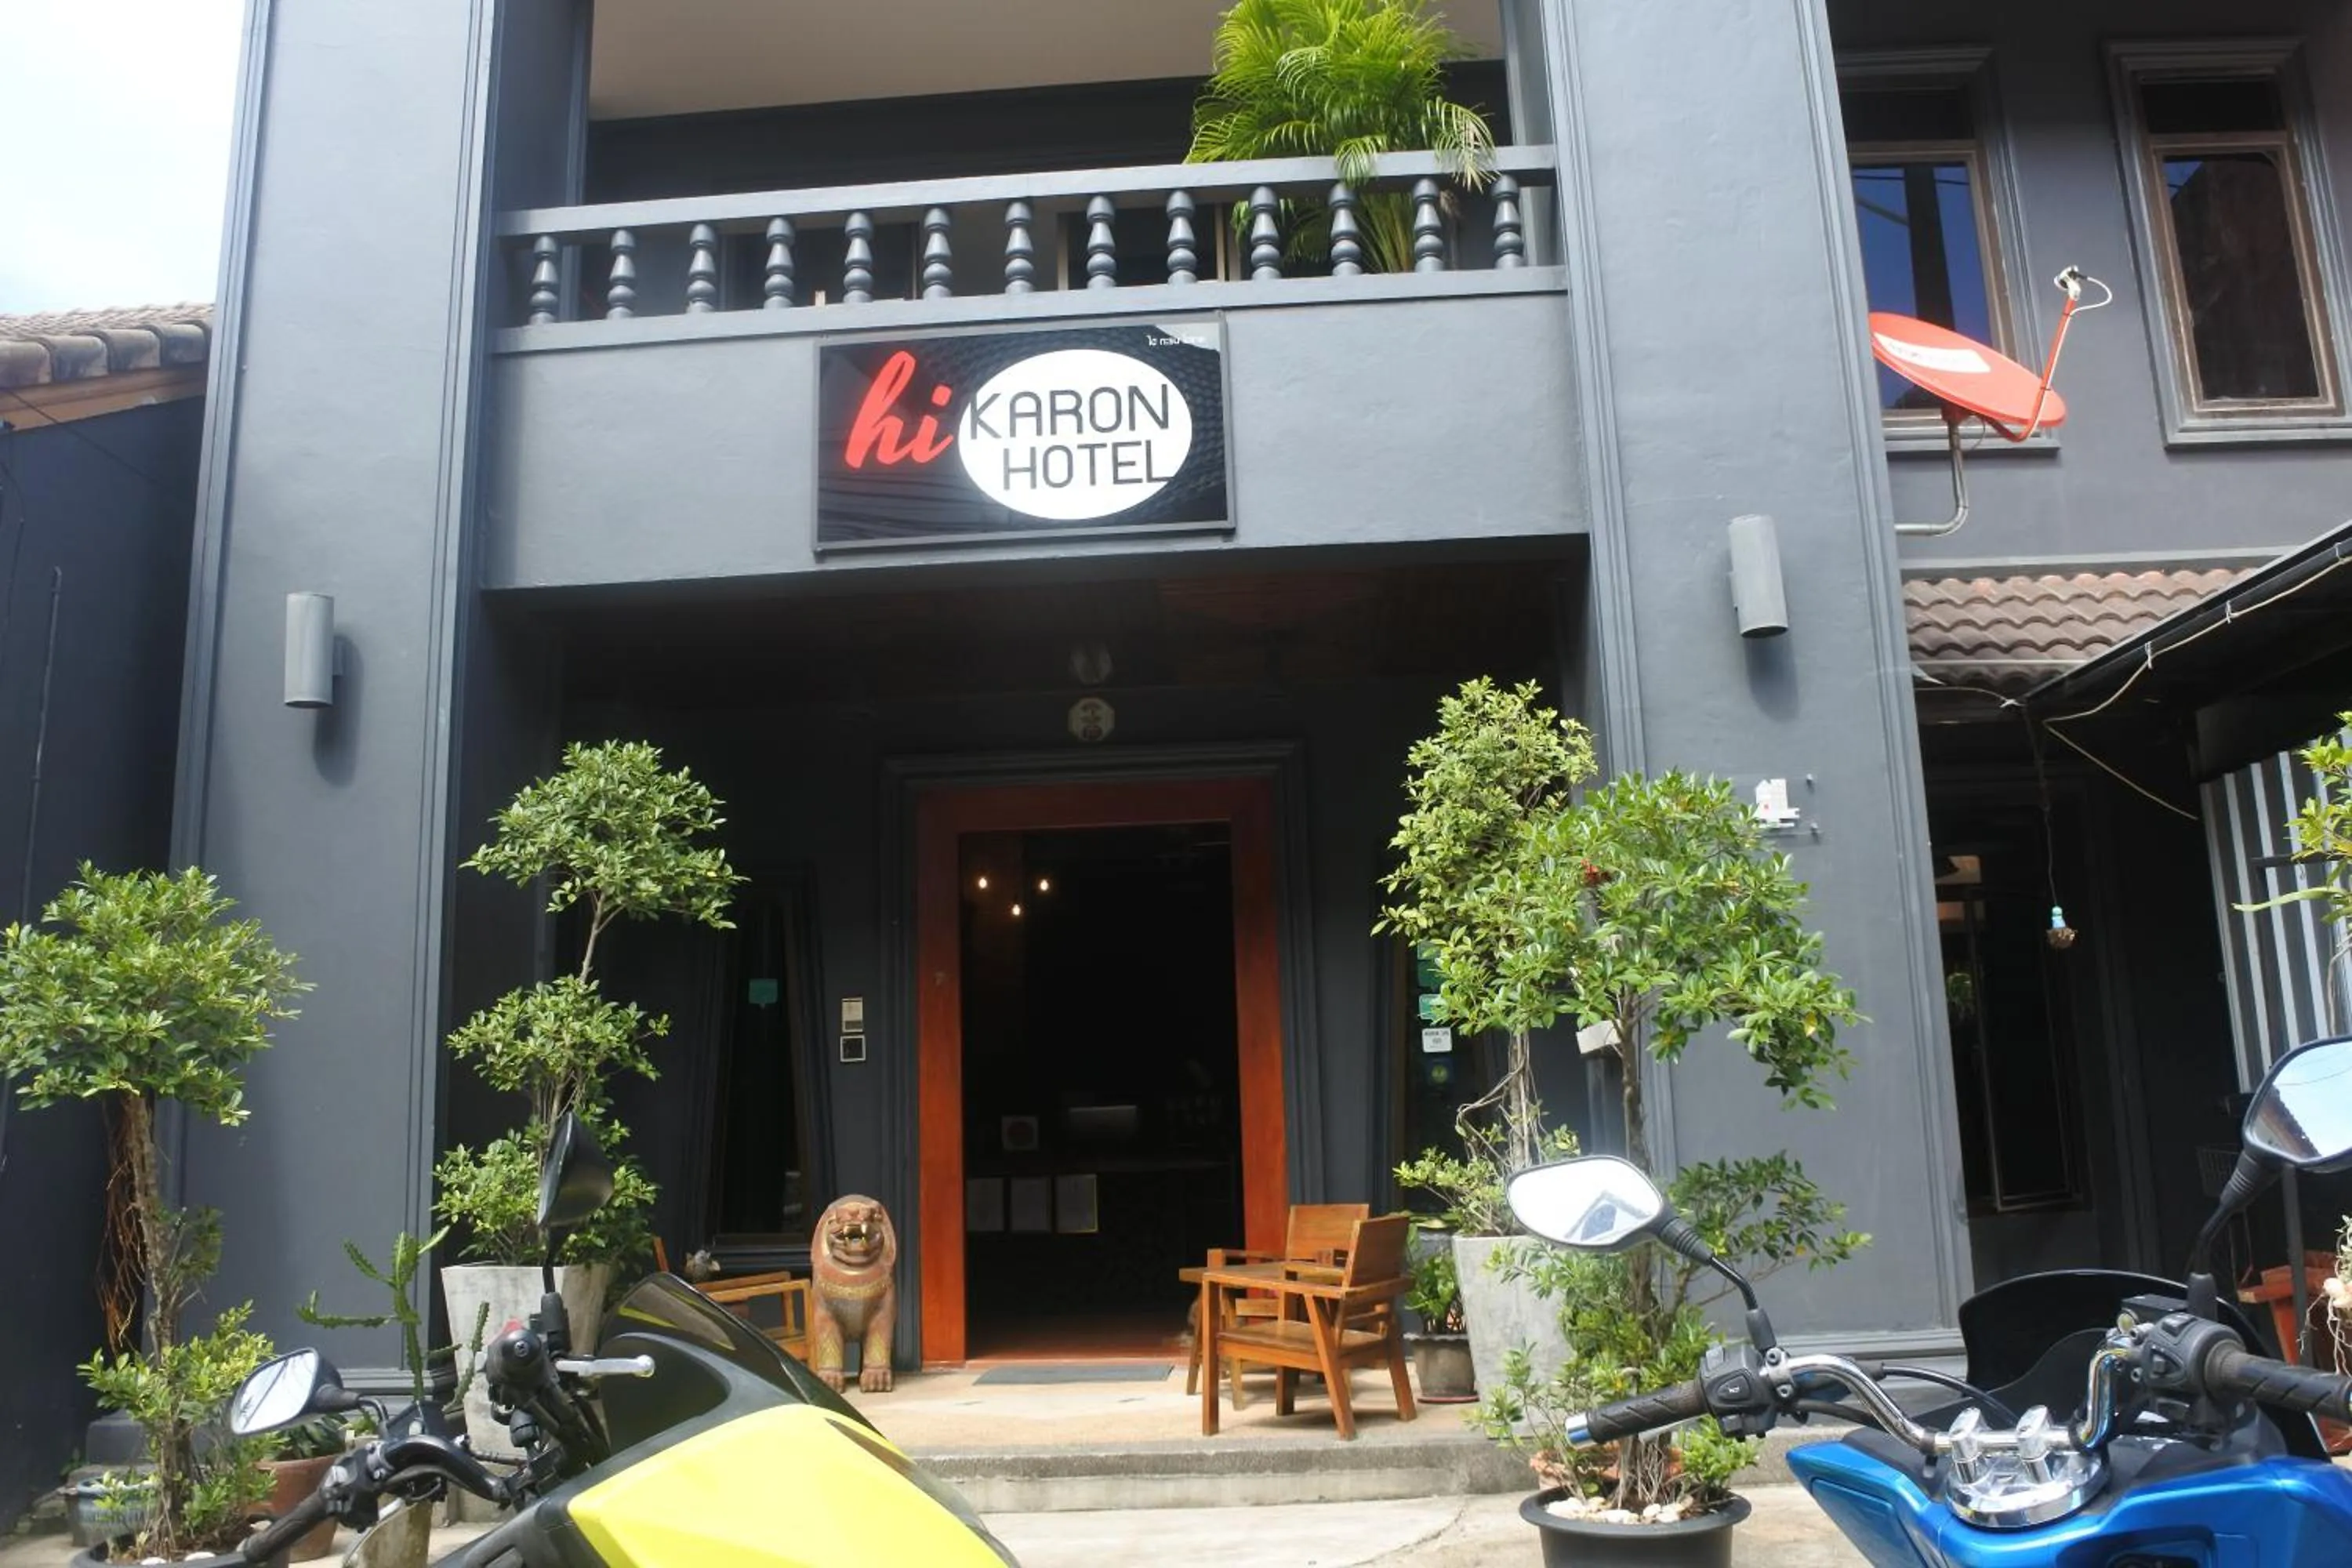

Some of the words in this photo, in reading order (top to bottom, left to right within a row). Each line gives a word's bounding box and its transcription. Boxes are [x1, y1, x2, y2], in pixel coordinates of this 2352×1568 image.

[844, 350, 954, 469] hi
[969, 383, 1170, 440] KARON
[1002, 439, 1174, 491] HOTEL
